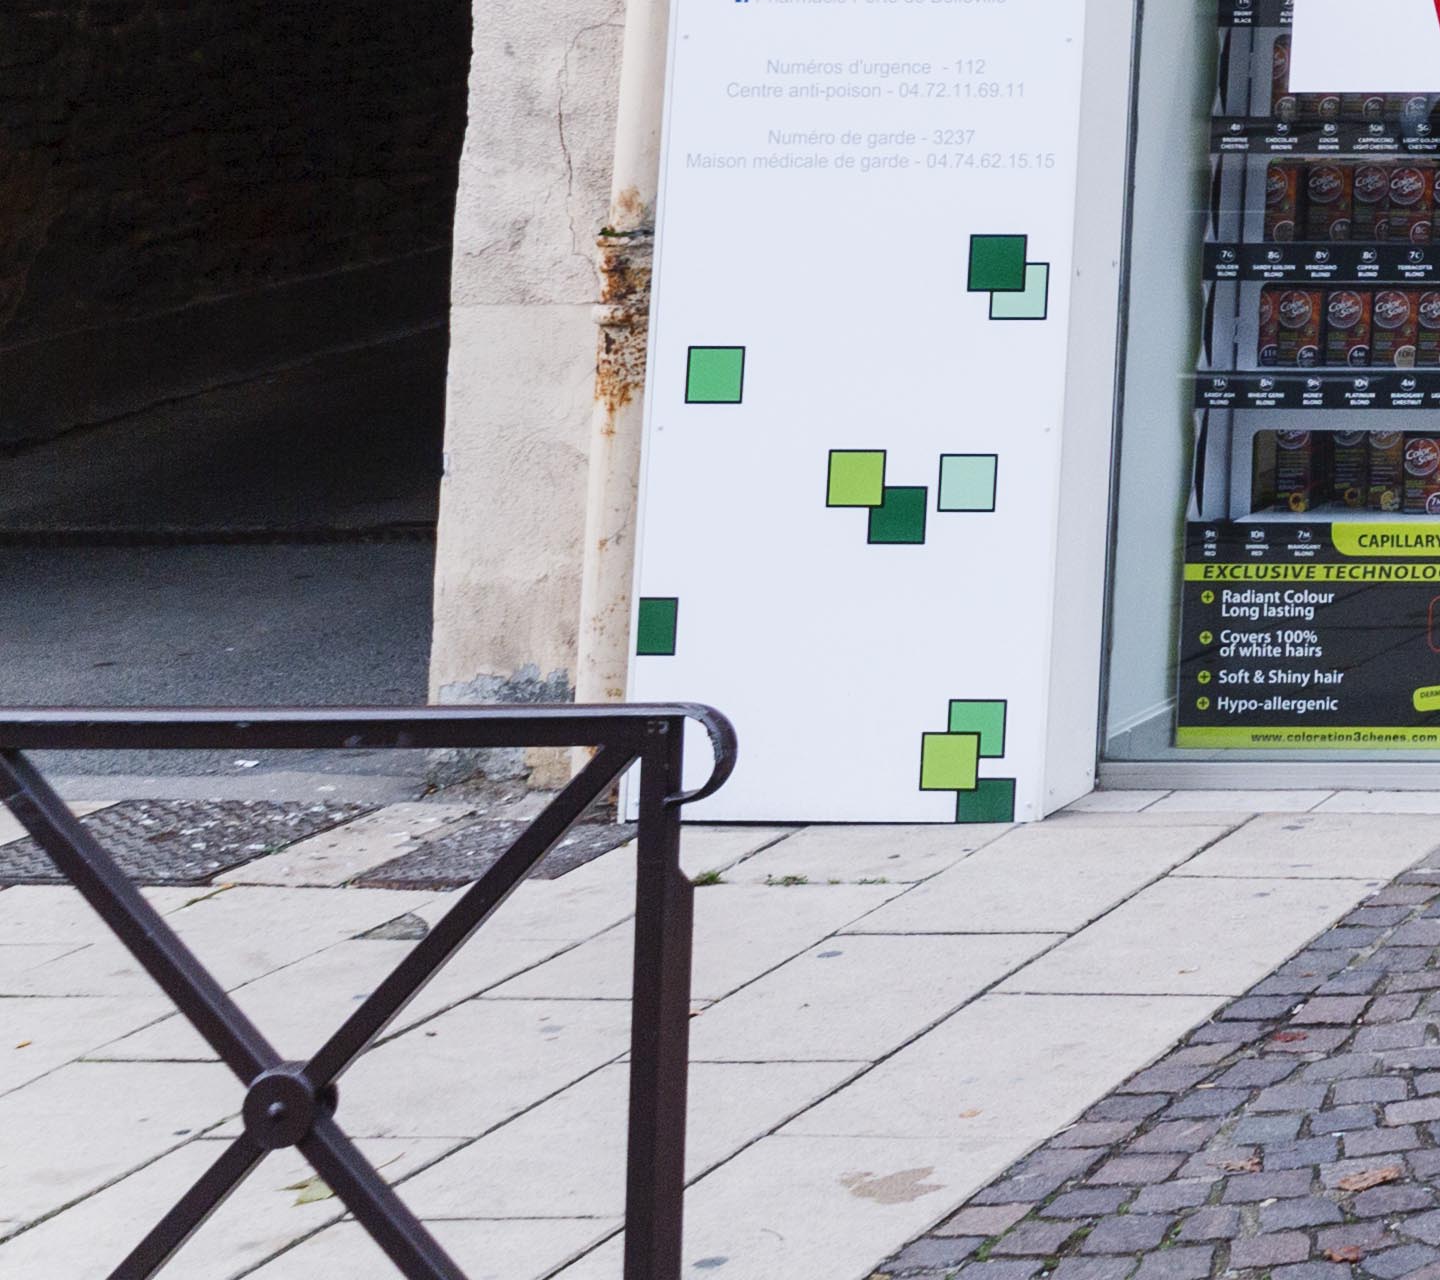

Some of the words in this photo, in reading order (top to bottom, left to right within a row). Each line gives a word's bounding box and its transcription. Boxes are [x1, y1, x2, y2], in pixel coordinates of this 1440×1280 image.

[1203, 565, 1316, 580] EXCLUSIVE
[1222, 590, 1281, 604] Radiant
[1284, 590, 1336, 604] Colour
[1222, 604, 1259, 620] Long
[1263, 604, 1315, 620] lasting
[1220, 630, 1271, 644] Covers
[1276, 630, 1318, 644] 100%
[1219, 643, 1236, 657] of
[1239, 643, 1283, 657] white
[1286, 643, 1323, 657] hairs
[1218, 670, 1249, 684] Soft
[1253, 671, 1265, 684] &
[1268, 670, 1309, 687] Shiny
[1314, 670, 1344, 684] hair
[1217, 696, 1339, 714] Hypo-allergenic
